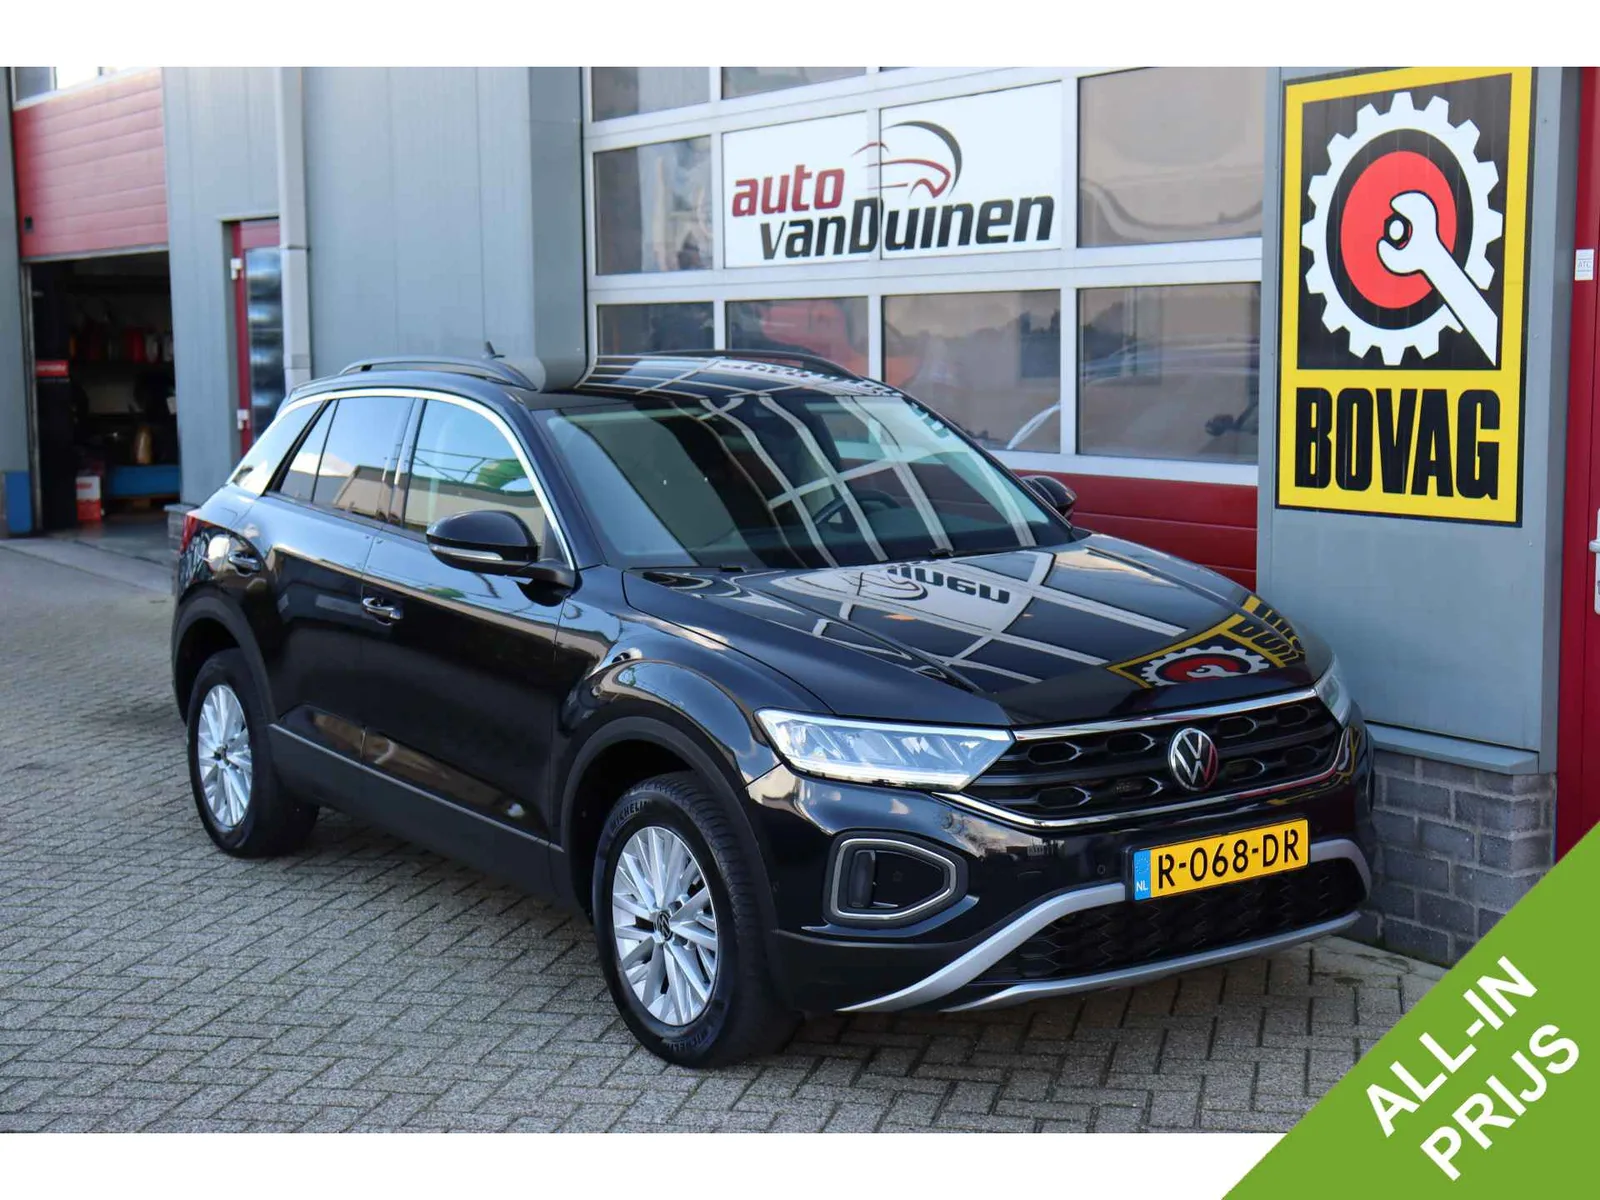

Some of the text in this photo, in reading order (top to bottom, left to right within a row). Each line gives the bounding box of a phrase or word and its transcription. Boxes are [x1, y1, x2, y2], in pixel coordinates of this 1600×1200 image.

[732, 164, 845, 217] auto
[760, 195, 1055, 260] vanDuinen
[1295, 387, 1501, 500] BOVAG
[1136, 881, 1149, 892] NL
[1158, 829, 1299, 889] R-068-DR
